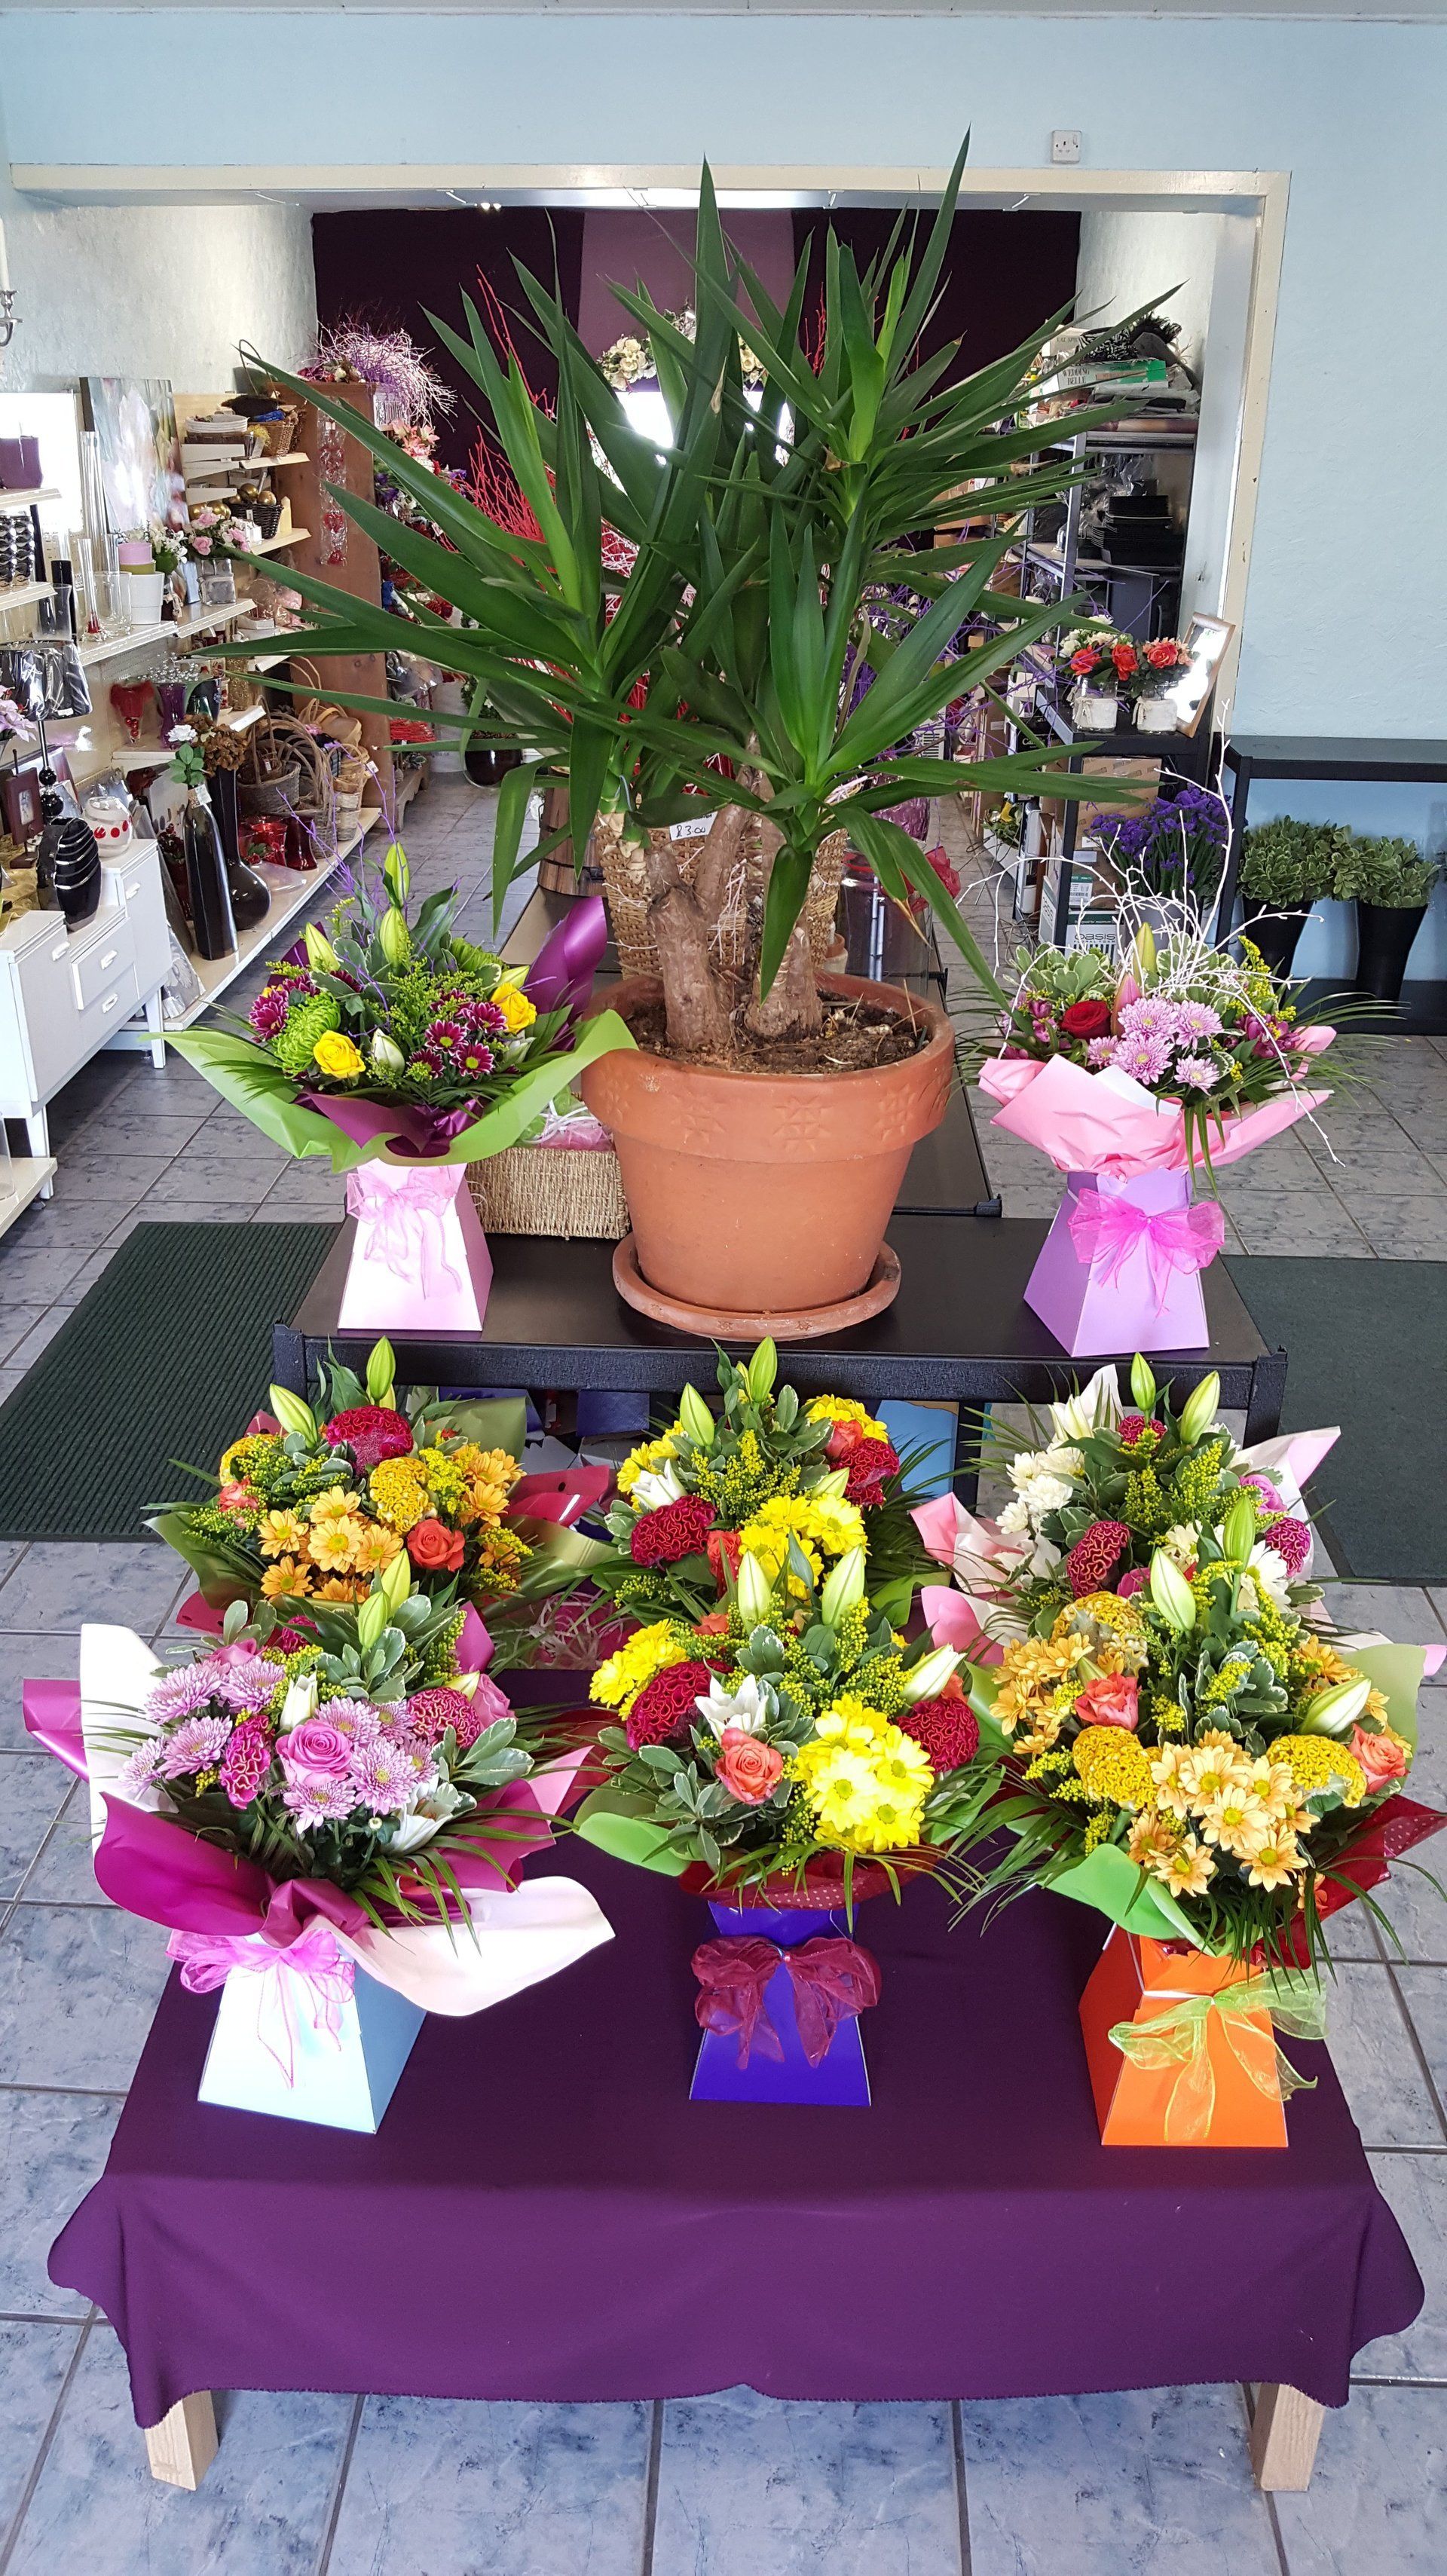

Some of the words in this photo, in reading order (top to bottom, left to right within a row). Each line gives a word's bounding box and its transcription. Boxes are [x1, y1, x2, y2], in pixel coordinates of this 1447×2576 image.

[1062, 367, 1090, 377] WEDDING
[1067, 376, 1086, 386] BELLE
[676, 825, 706, 838] £3.00
